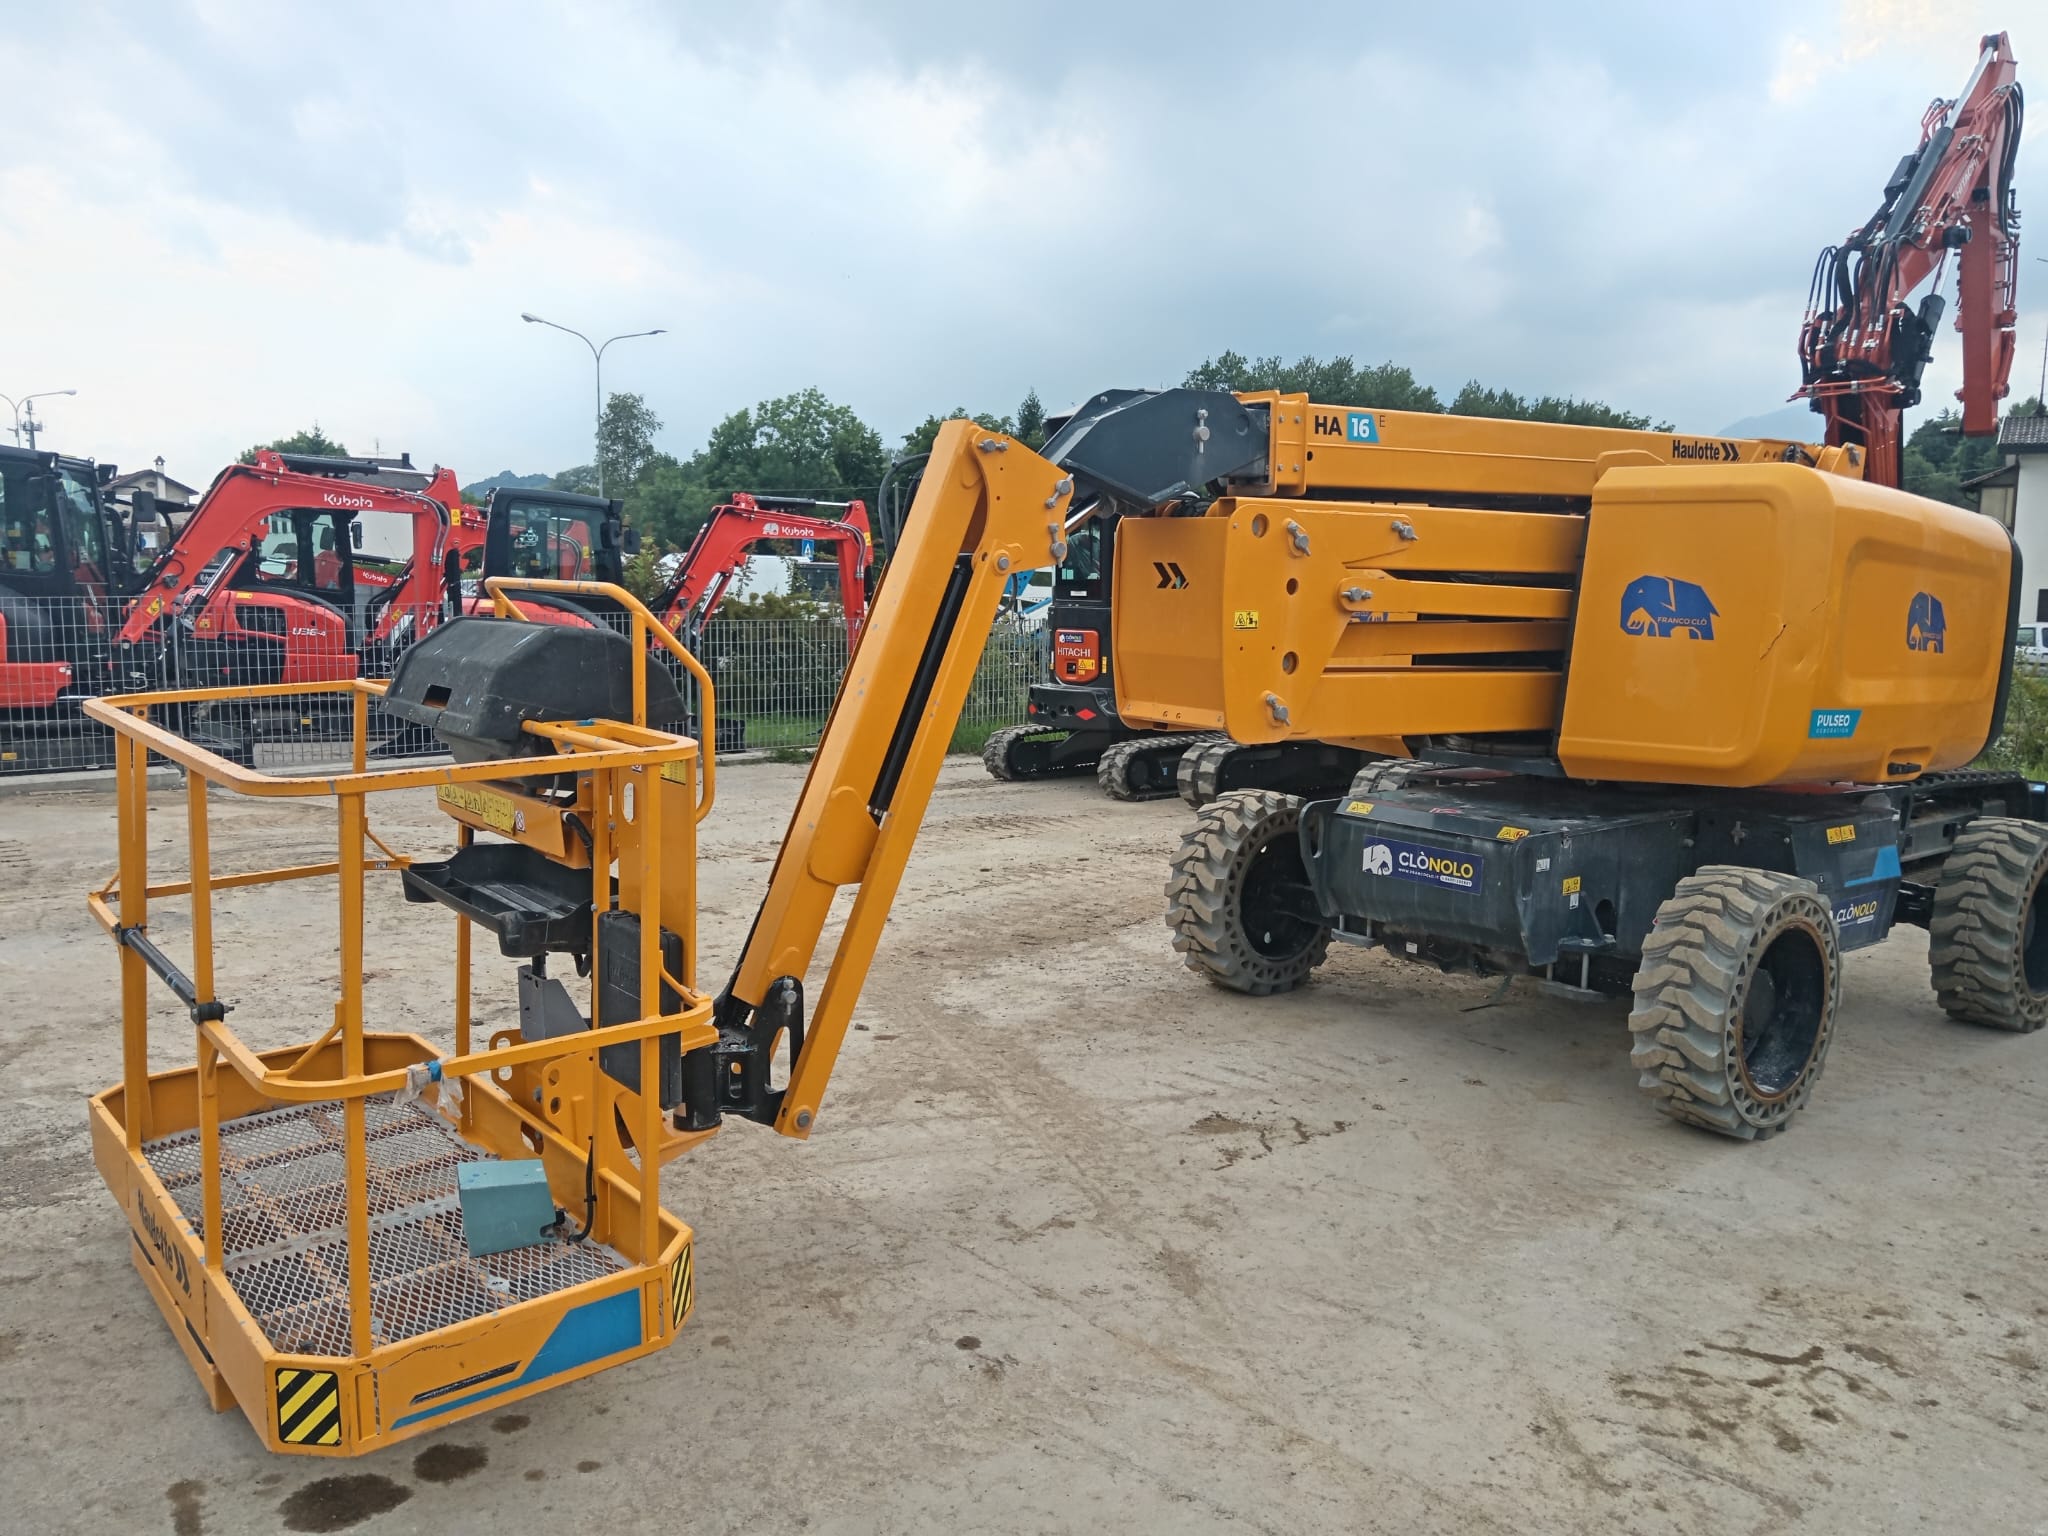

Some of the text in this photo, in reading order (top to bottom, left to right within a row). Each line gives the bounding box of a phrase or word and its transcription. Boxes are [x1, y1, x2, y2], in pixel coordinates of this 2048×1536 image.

[1314, 414, 1386, 438] HA 16 E
[1672, 439, 1720, 460] Haulotte
[323, 493, 373, 508] Kubota
[781, 526, 815, 537] Kubota
[362, 571, 388, 584] Kubota
[1657, 616, 1690, 625] FRANCO
[1057, 647, 1091, 657] HITACHI
[1816, 714, 1850, 727] PULSEO
[1398, 851, 1474, 878] CLÒNOLO
[1836, 900, 1878, 922] CLÒNOLO
[137, 1188, 174, 1271] Haulotte
